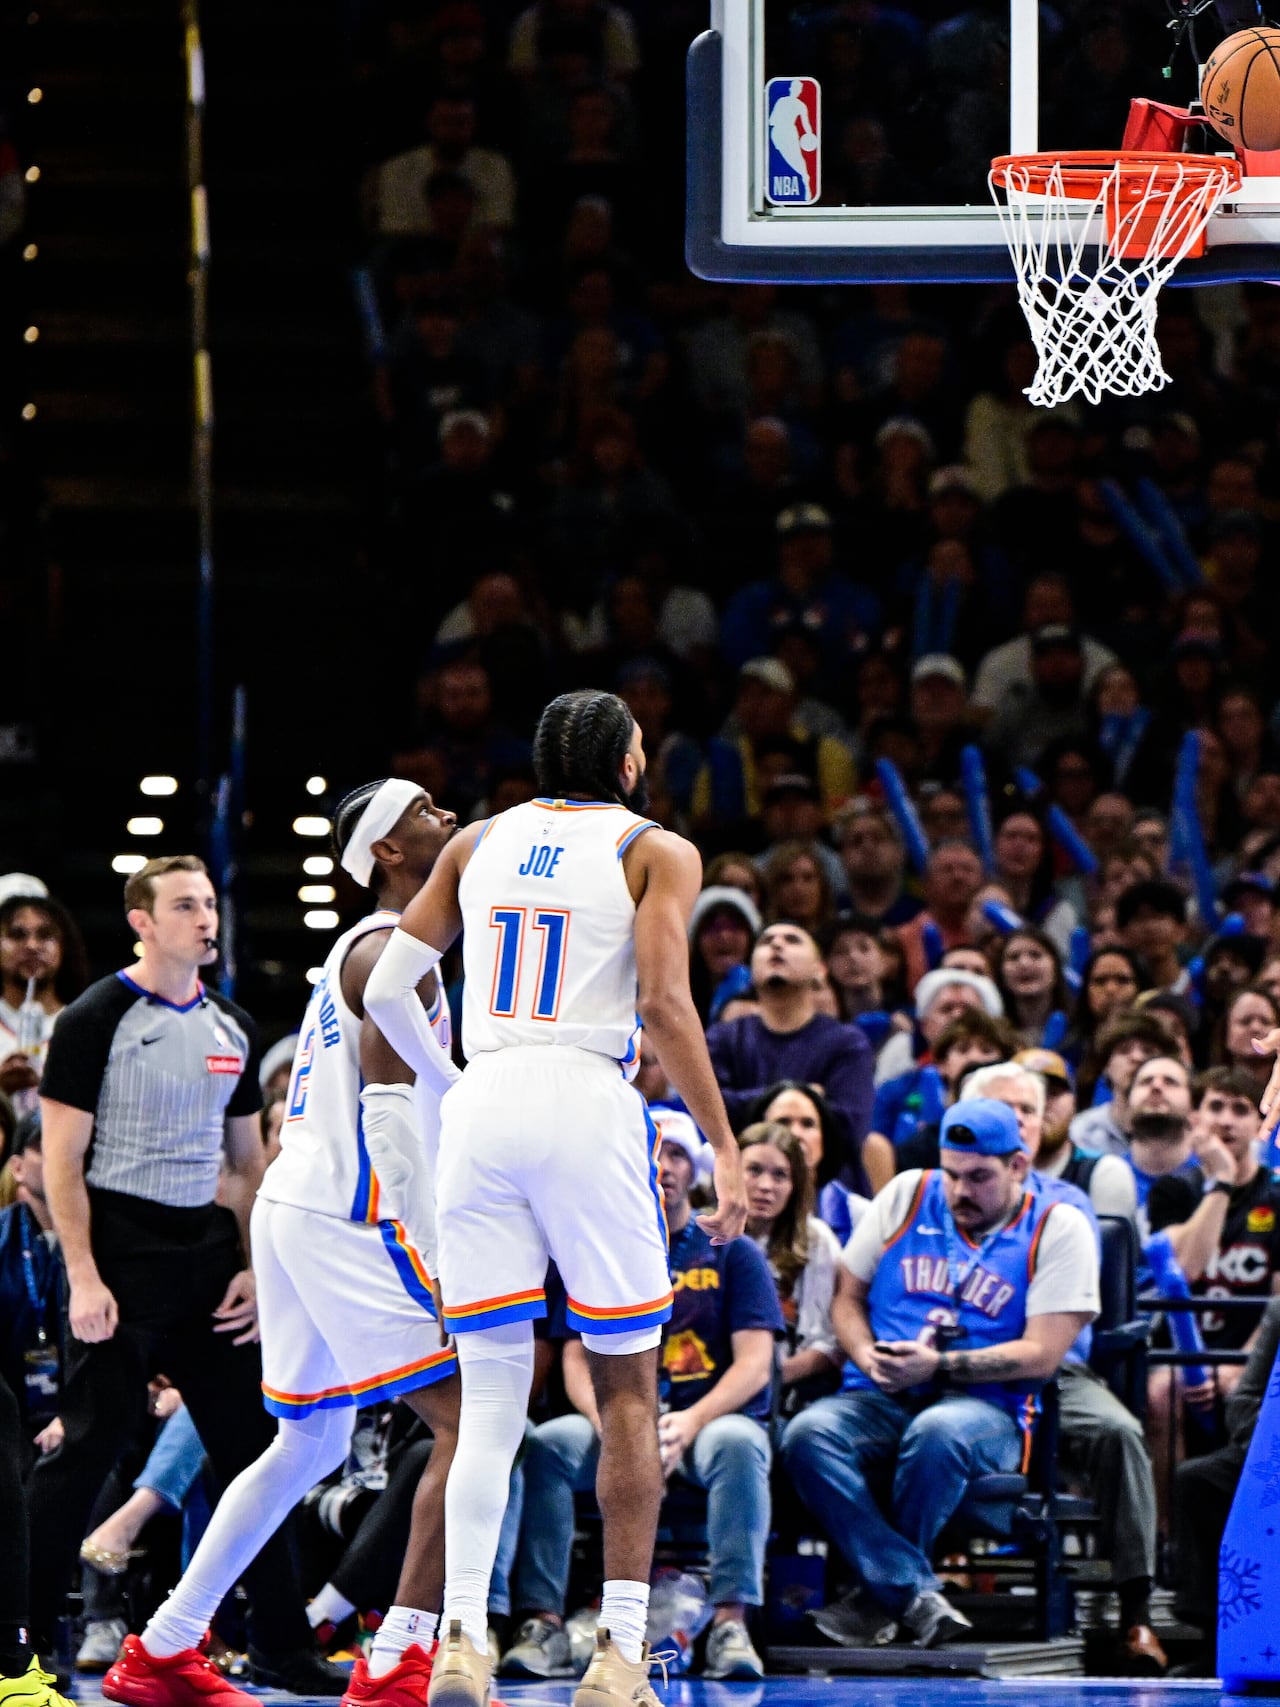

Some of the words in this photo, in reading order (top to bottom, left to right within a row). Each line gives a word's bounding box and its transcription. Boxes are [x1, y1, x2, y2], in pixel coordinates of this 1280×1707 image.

[773, 175, 800, 197] NBA
[518, 845, 565, 878] JOE
[489, 906, 572, 1022] 11
[286, 1023, 317, 1122] 2
[1205, 1246, 1268, 1283] KC
